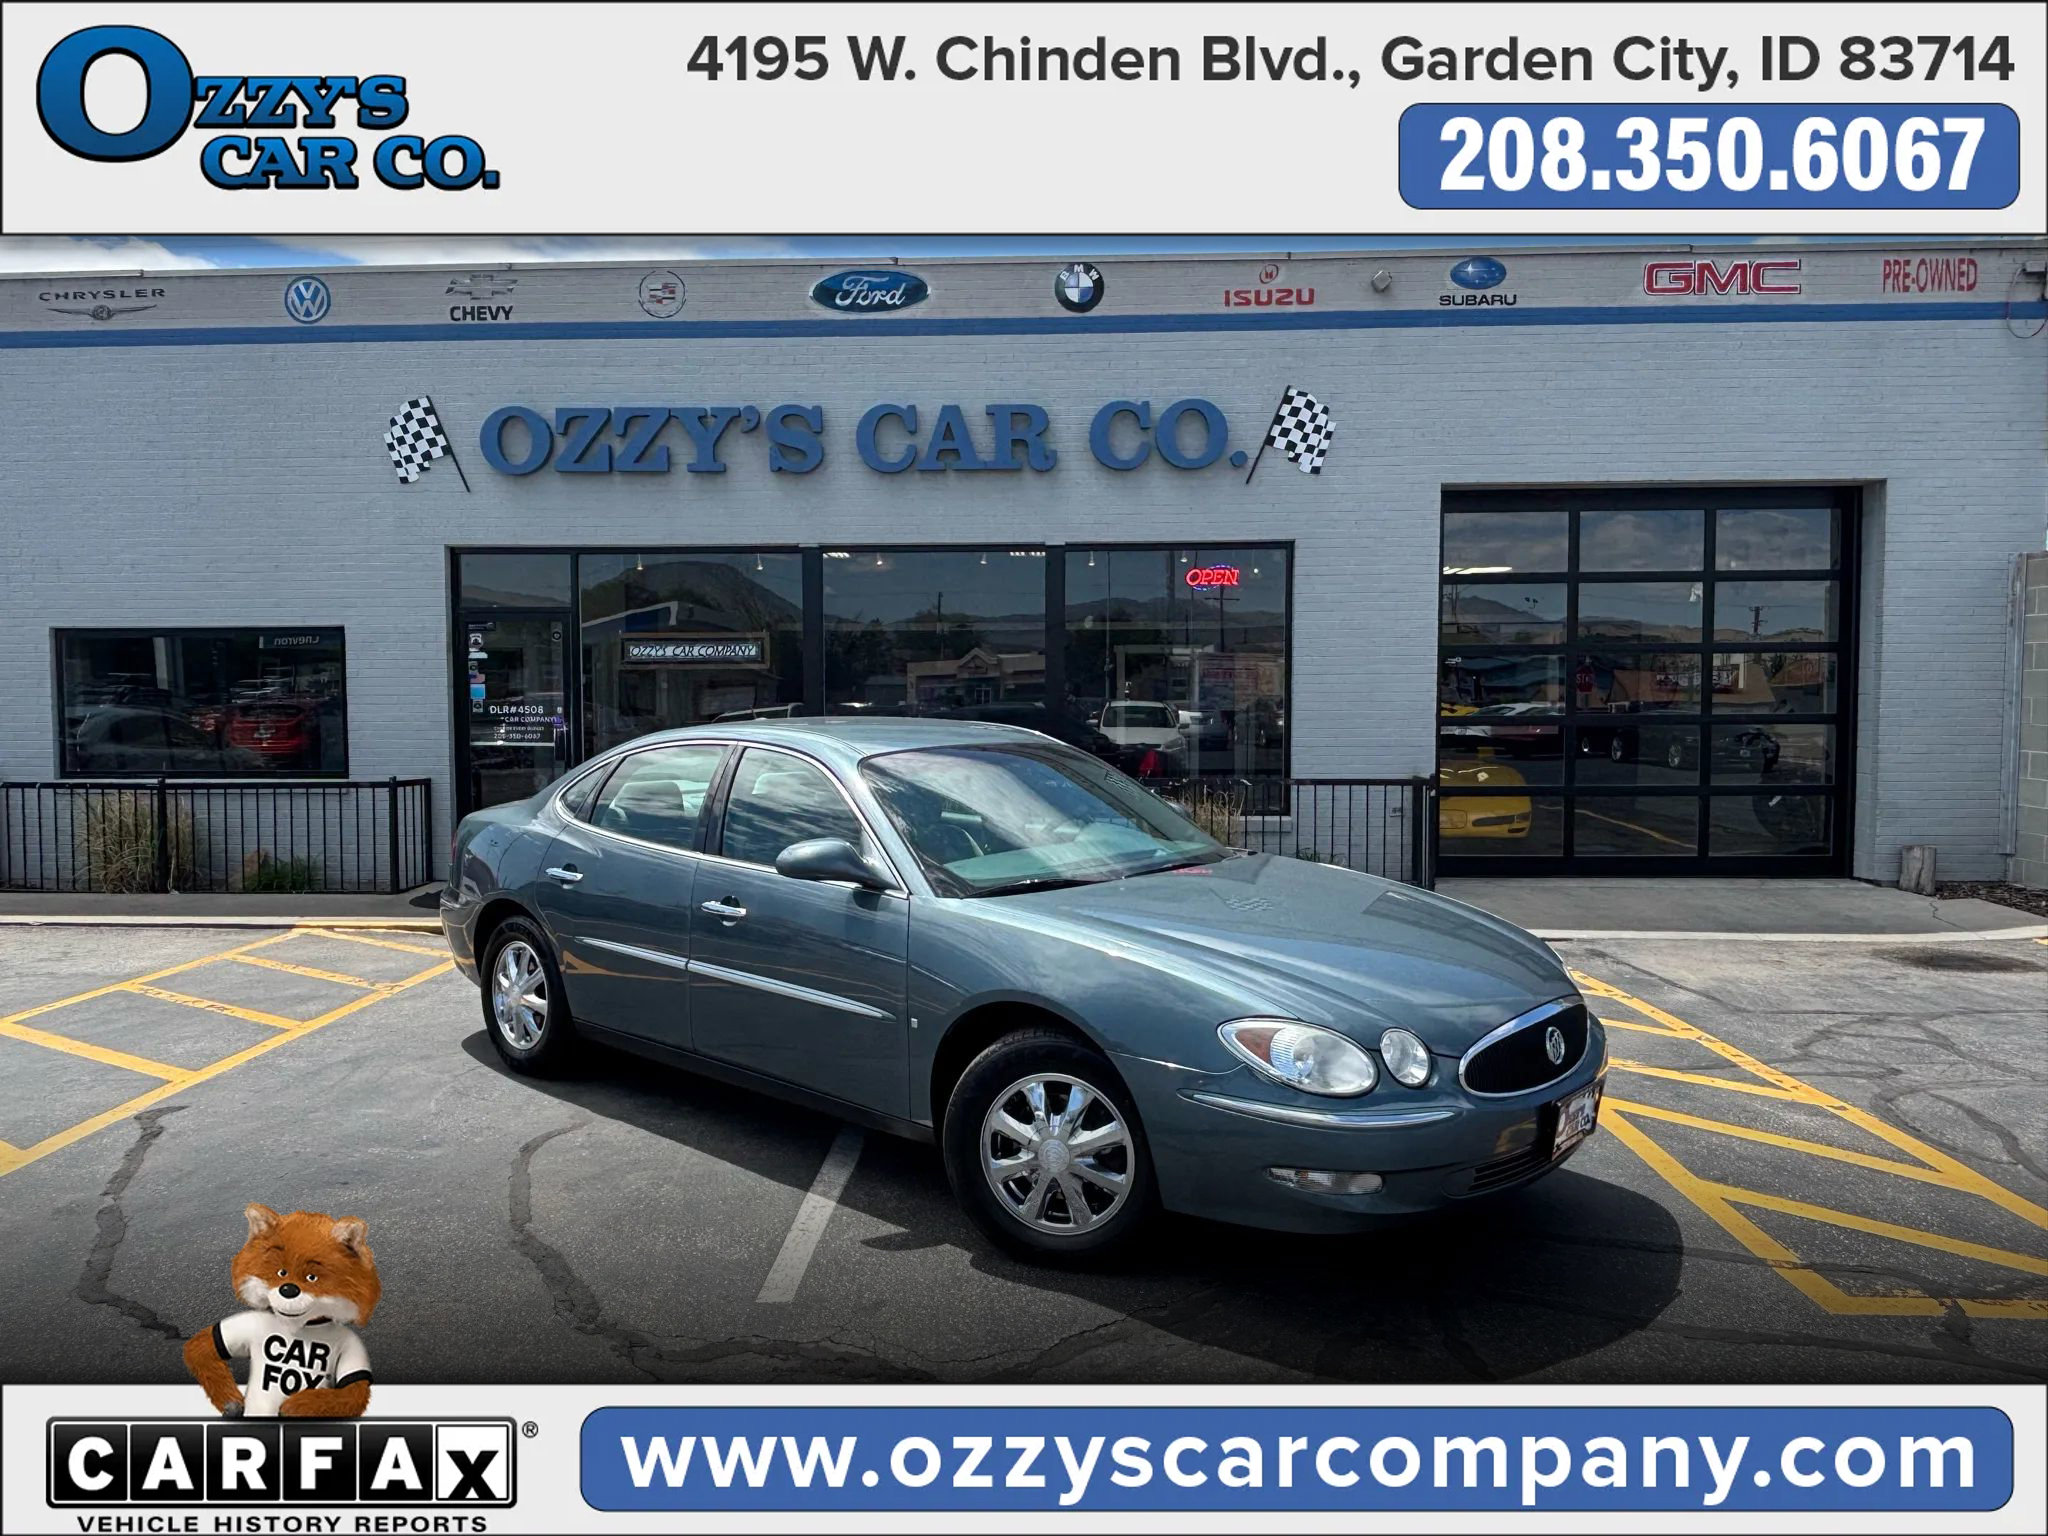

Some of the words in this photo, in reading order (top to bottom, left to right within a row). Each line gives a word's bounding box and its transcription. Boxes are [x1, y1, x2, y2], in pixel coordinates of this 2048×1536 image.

[1059, 264, 1101, 282] BMW
[1644, 260, 1801, 295] GMC
[1883, 257, 1979, 293] PRE-OWNED
[39, 288, 165, 301] CHRYSLER
[835, 276, 906, 306] Ford
[1224, 288, 1315, 307] ISUZU
[1439, 294, 1517, 306] SUBARU
[450, 305, 514, 322] CHEVY
[479, 405, 825, 475] OZZY'S
[856, 404, 1057, 473] CAR
[1089, 398, 1249, 470] CO.
[1186, 569, 1239, 586] OPEN
[672, 645, 695, 657] CAR
[698, 645, 756, 657] COMPANY
[489, 705, 544, 714] DLR#4508
